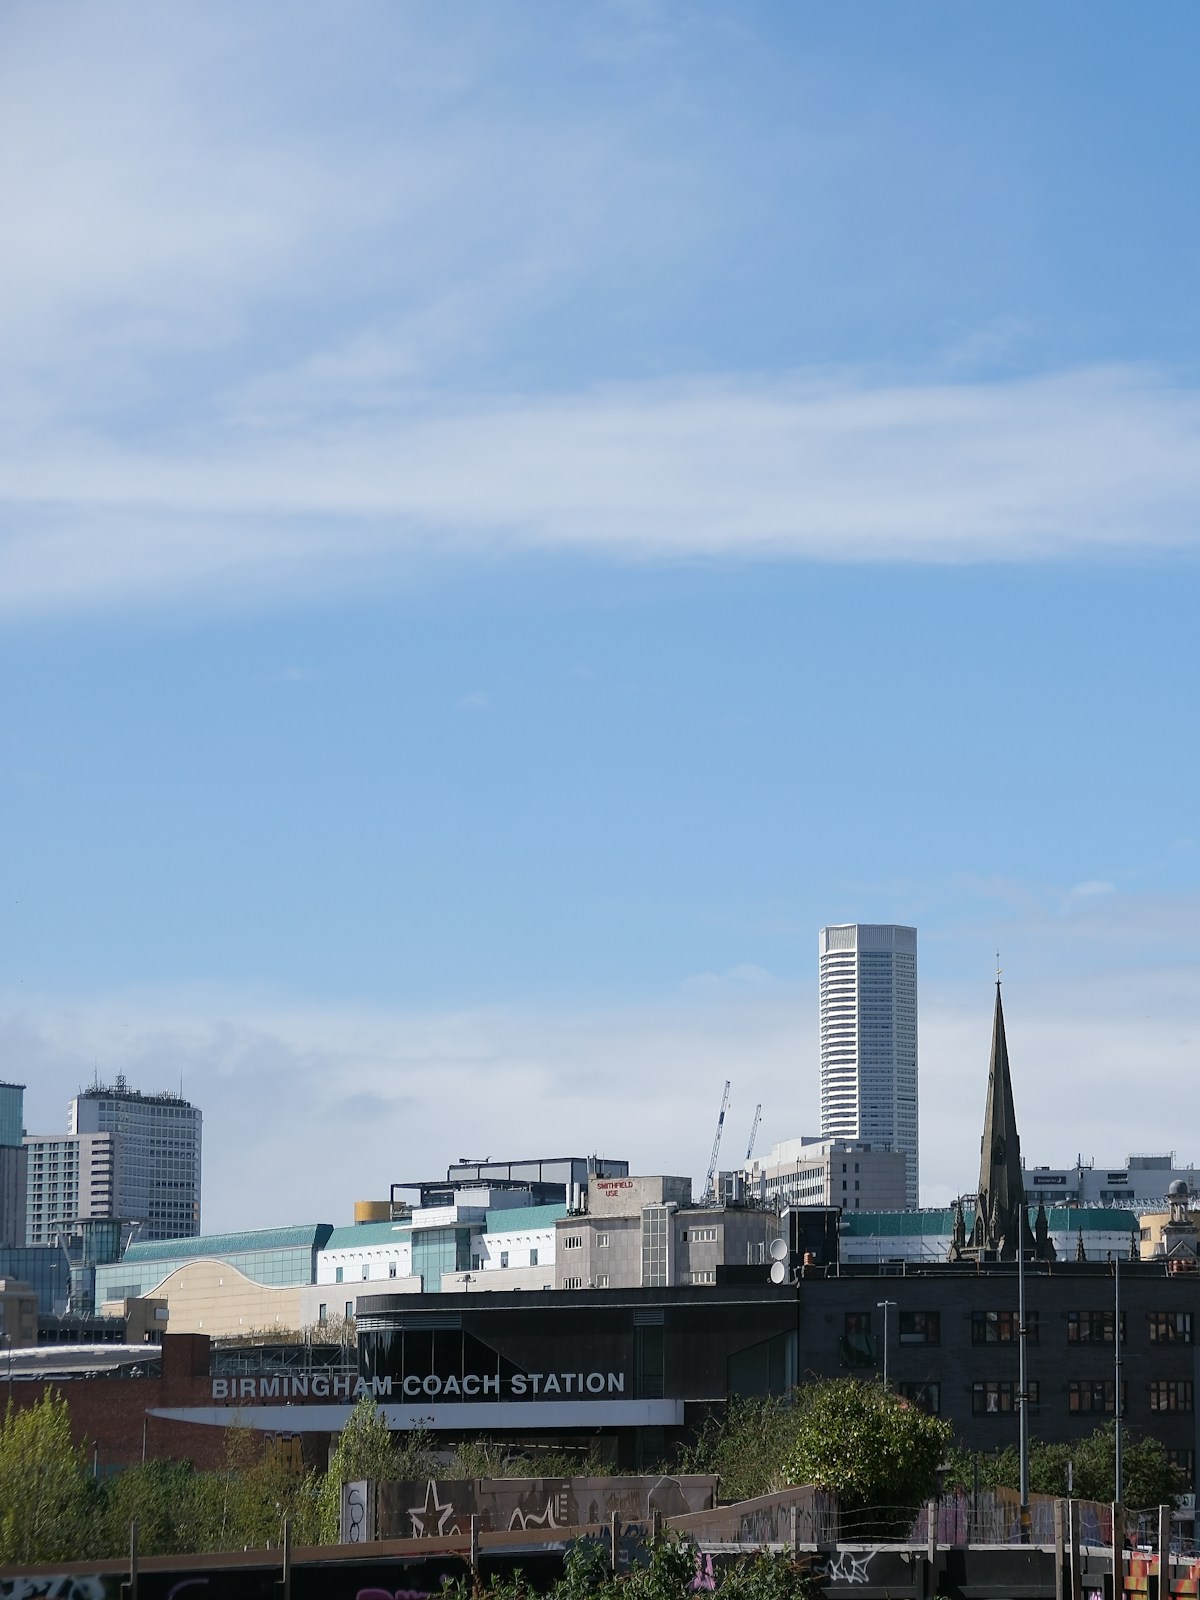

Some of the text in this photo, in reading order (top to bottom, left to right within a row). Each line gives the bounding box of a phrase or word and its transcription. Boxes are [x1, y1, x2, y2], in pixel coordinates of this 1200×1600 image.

[597, 1181, 633, 1189] SMITHFIELD
[212, 1372, 625, 1399] BIRMINGHAM COACH STATION
